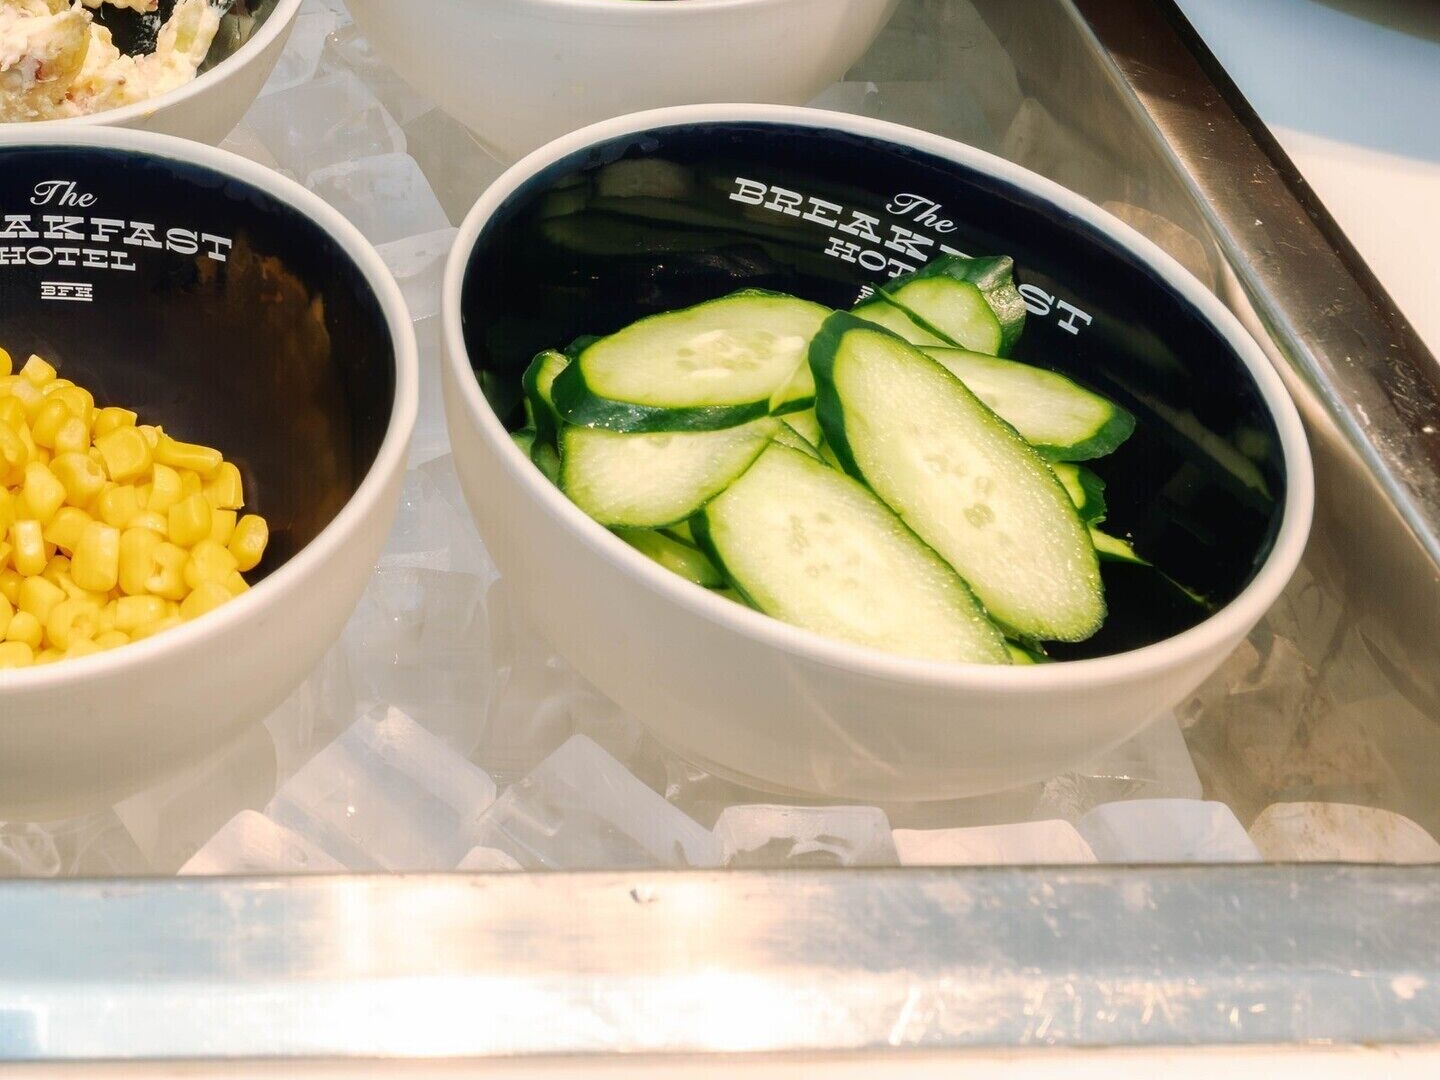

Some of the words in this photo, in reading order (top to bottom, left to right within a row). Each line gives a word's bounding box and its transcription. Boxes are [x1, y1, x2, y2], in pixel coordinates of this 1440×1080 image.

[29, 179, 99, 209] The
[886, 192, 959, 234] The
[729, 177, 1094, 336] BREAKST
[824, 237, 918, 278] HOT
[41, 283, 93, 300] BFH
